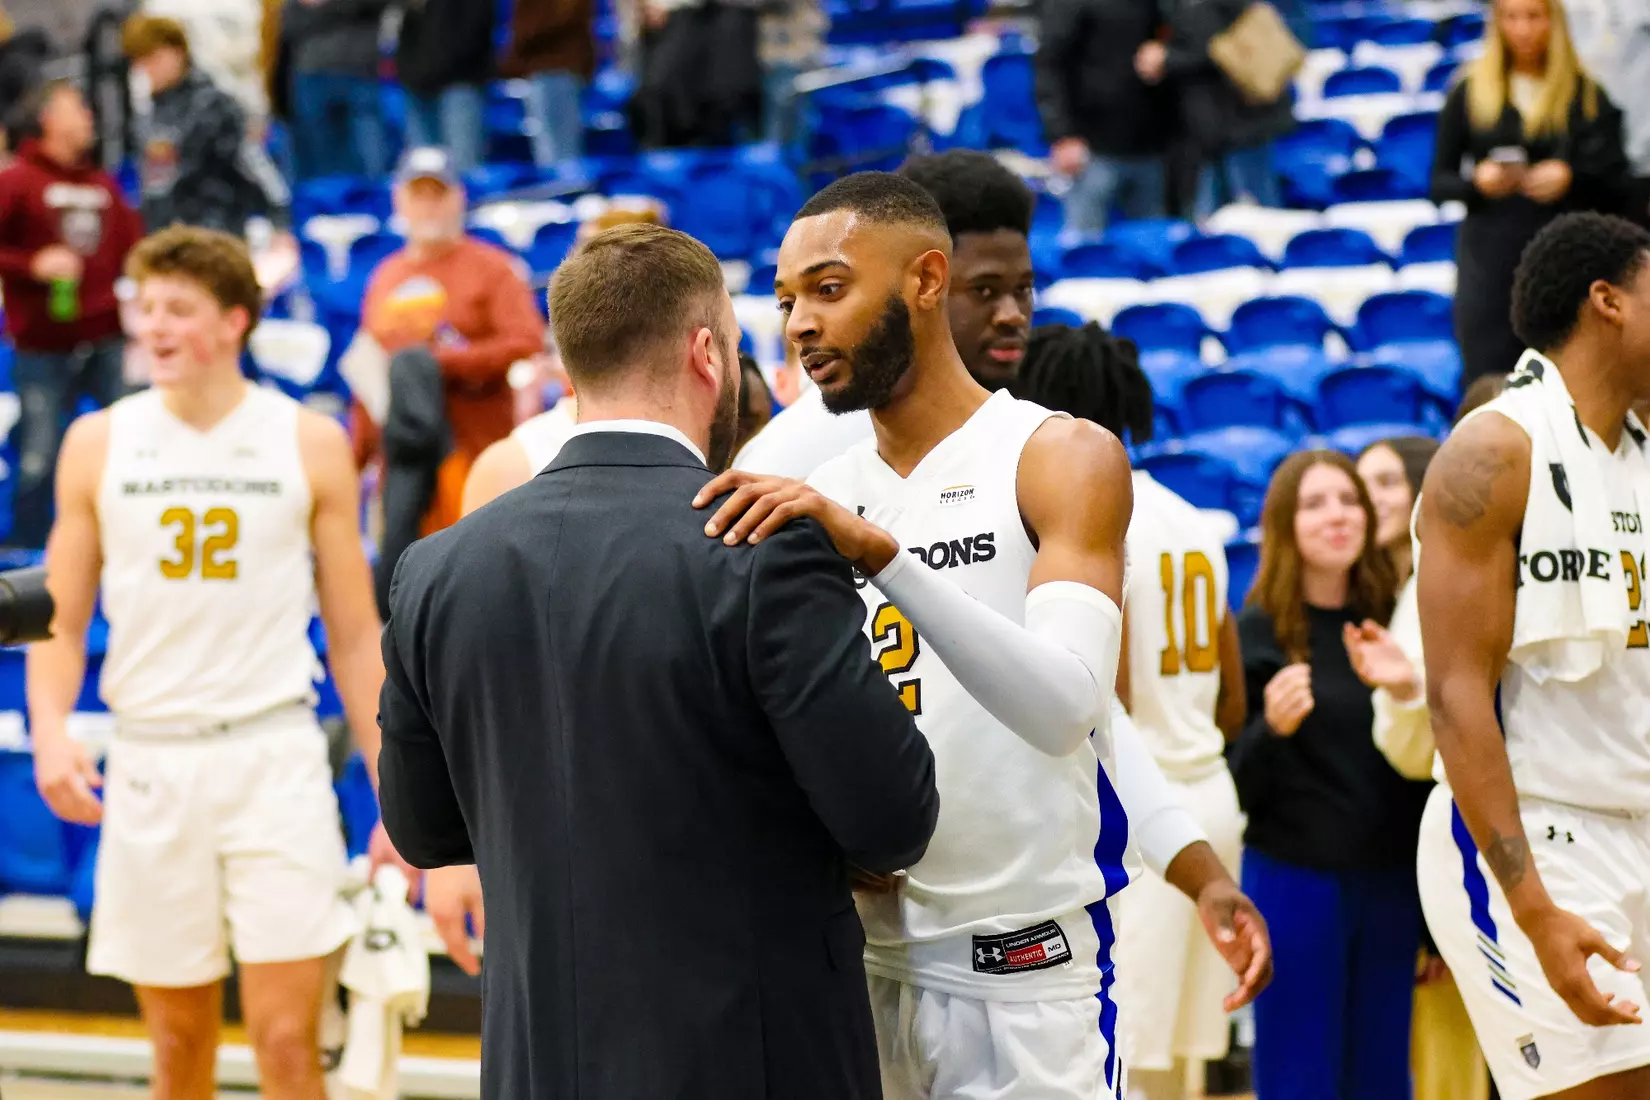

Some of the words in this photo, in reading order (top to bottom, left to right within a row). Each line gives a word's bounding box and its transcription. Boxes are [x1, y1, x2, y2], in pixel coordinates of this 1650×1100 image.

[941, 488, 975, 499] HORIZON
[1611, 510, 1643, 534] STO
[159, 506, 239, 580] 32
[1160, 551, 1218, 676] 10
[871, 601, 922, 716] 2
[1005, 938, 1030, 949] UNDER
[1030, 928, 1057, 942] ARMOUR
[1047, 943, 1062, 953] MD
[1009, 949, 1044, 962] AUTHENTIC
